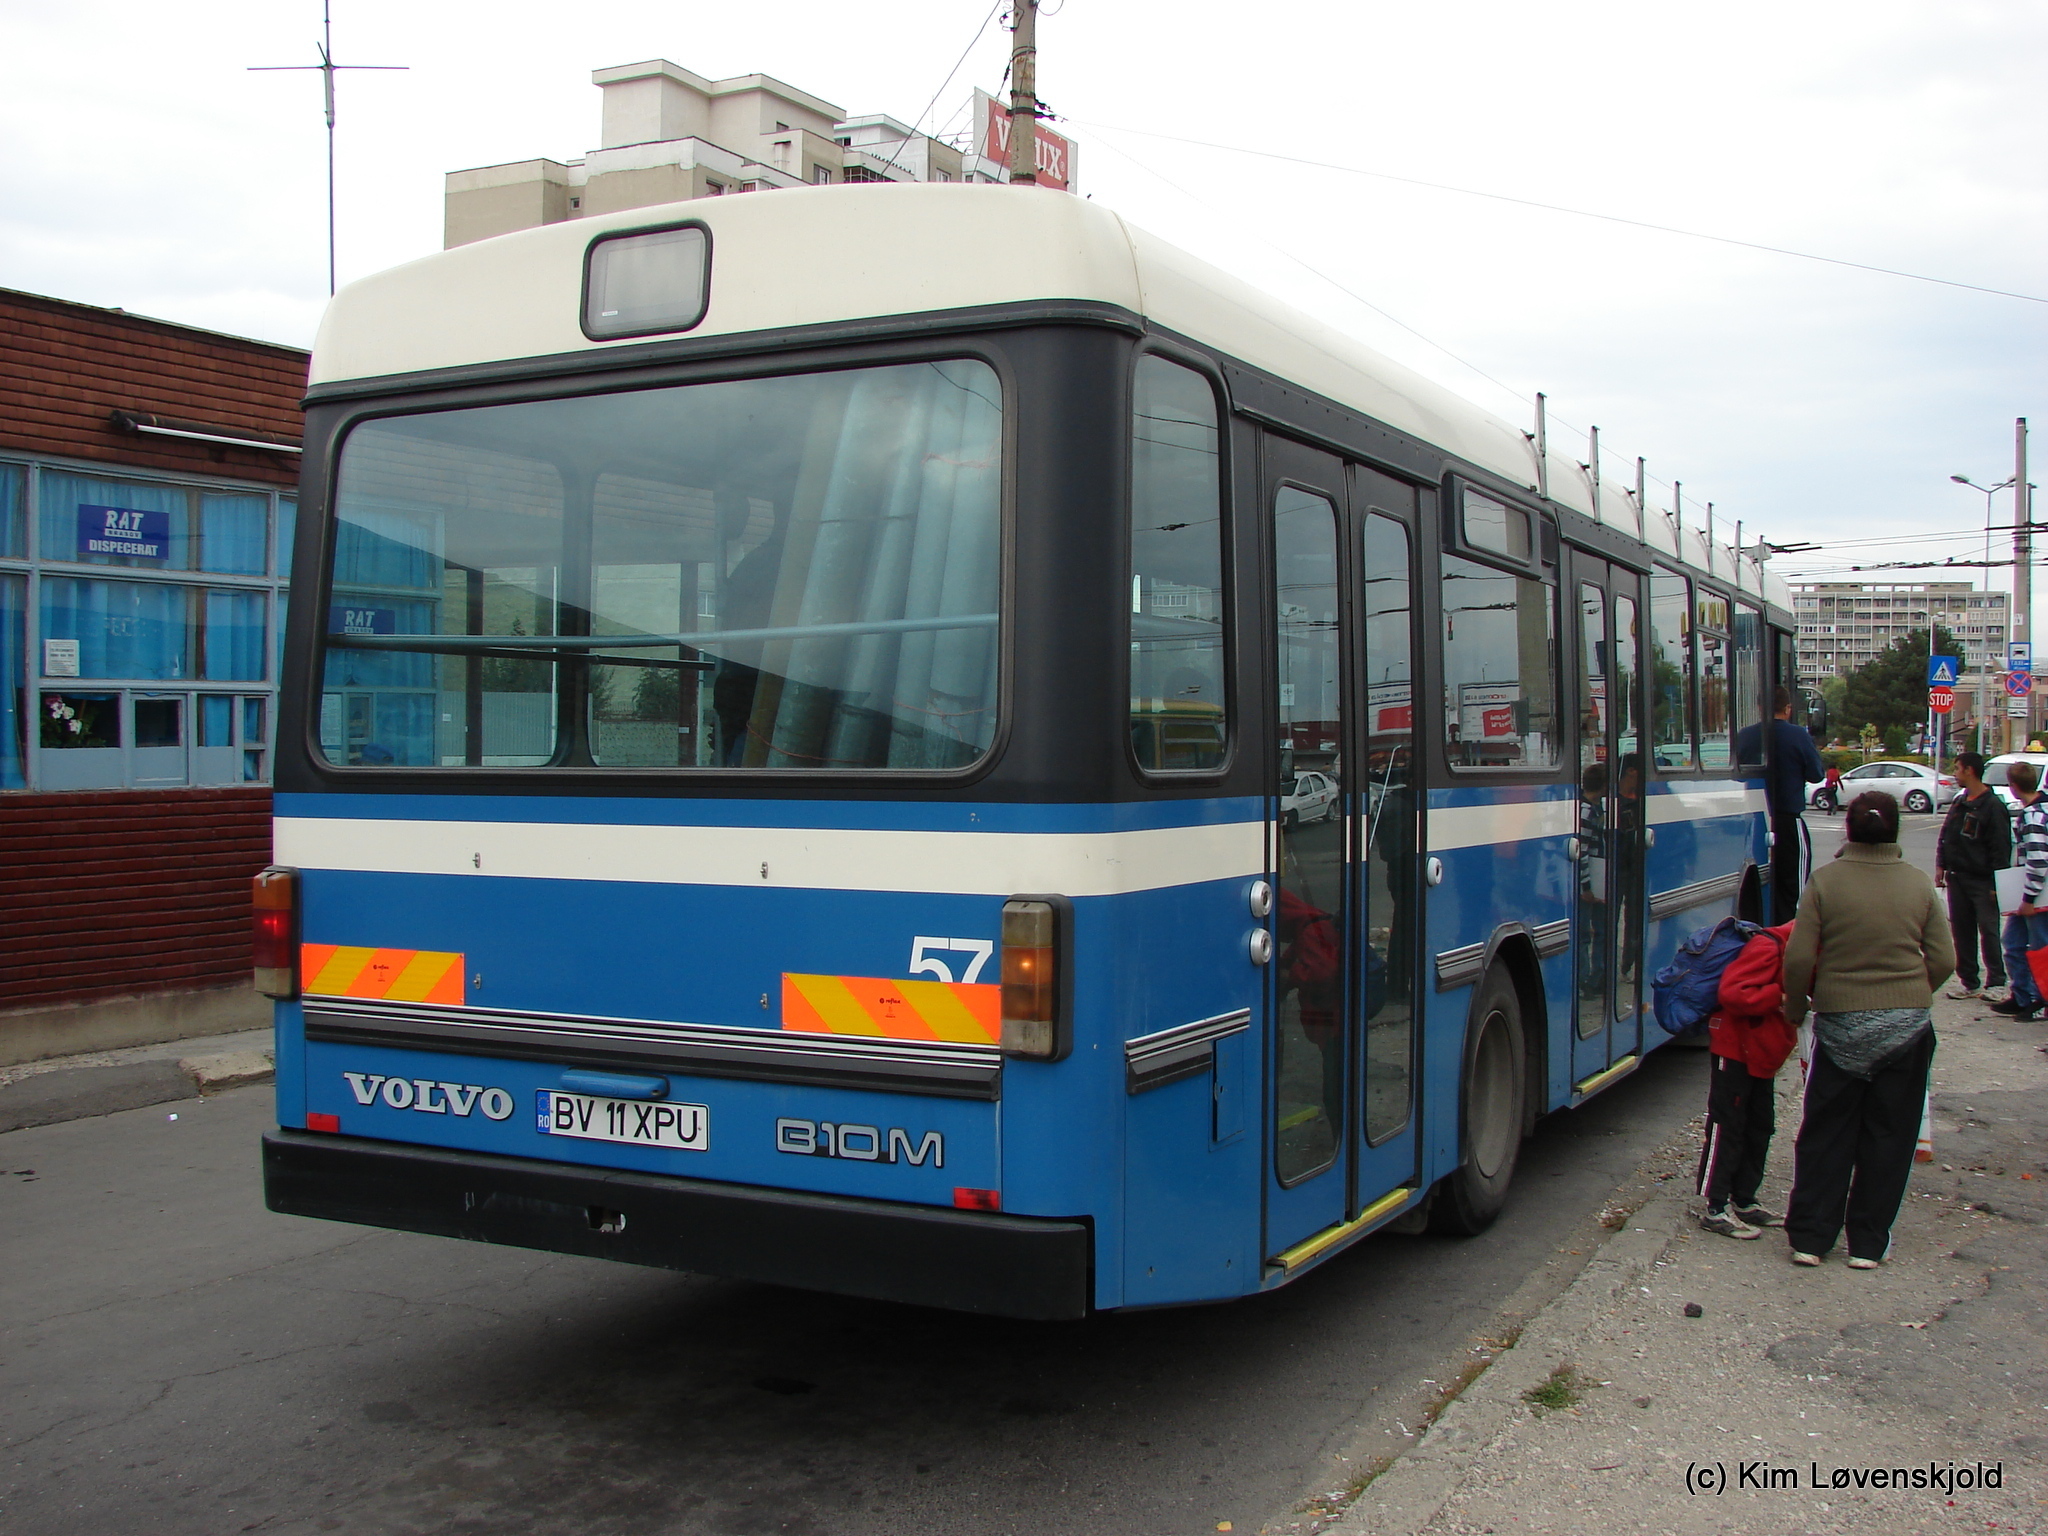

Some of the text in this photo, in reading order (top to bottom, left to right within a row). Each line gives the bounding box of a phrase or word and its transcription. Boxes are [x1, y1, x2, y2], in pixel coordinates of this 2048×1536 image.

[996, 115, 1062, 181] VUX
[106, 510, 144, 531] RAT
[89, 539, 158, 557] DISPECERAT
[345, 610, 375, 627] RAT
[1929, 693, 1953, 706] STOP
[909, 936, 993, 984] 57
[344, 1072, 514, 1121] VOLVO
[538, 1115, 550, 1128] RO
[555, 1096, 698, 1142] BV 11 XPU
[776, 1117, 944, 1168] B10M
